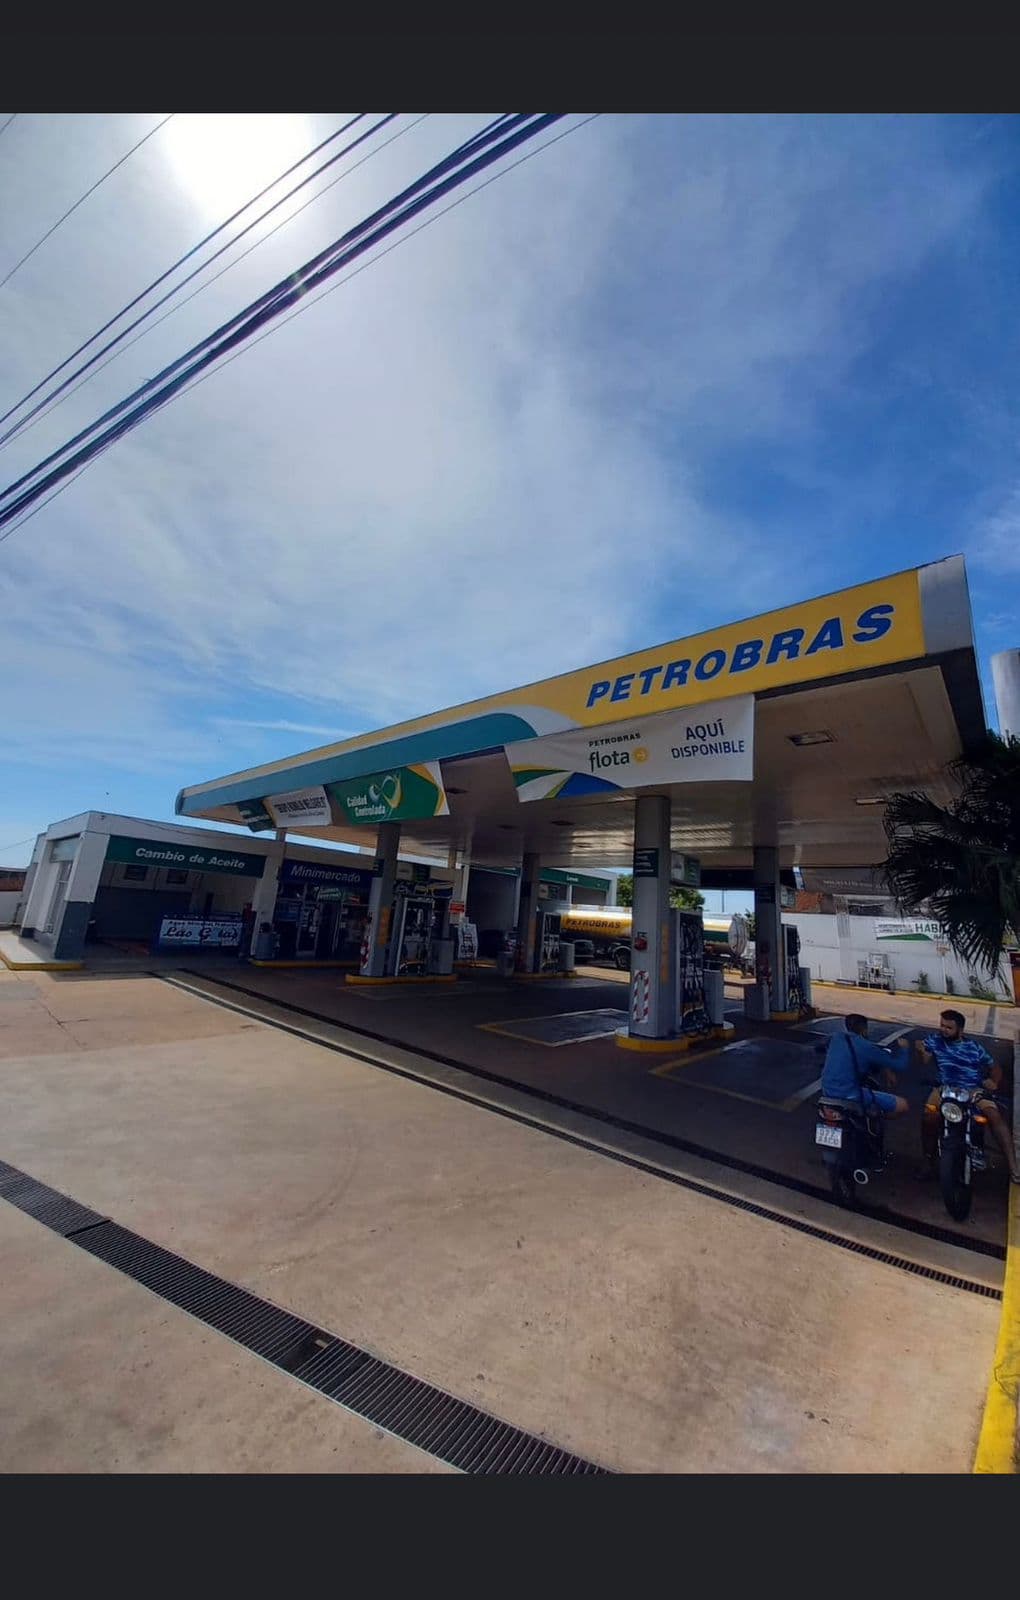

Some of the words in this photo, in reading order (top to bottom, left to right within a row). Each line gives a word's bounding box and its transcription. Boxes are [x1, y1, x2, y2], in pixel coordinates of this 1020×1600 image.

[586, 604, 895, 708] PETROBRAS
[685, 718, 725, 741] AQUÍ
[588, 733, 642, 748] PETROBRAS
[671, 739, 746, 760] DISPONIBLE
[589, 749, 631, 773] flota
[135, 847, 186, 862] Cambio
[189, 854, 205, 864] de
[207, 856, 246, 869] Aceite
[290, 864, 361, 882] Minimercado
[915, 923, 942, 934] HABI
